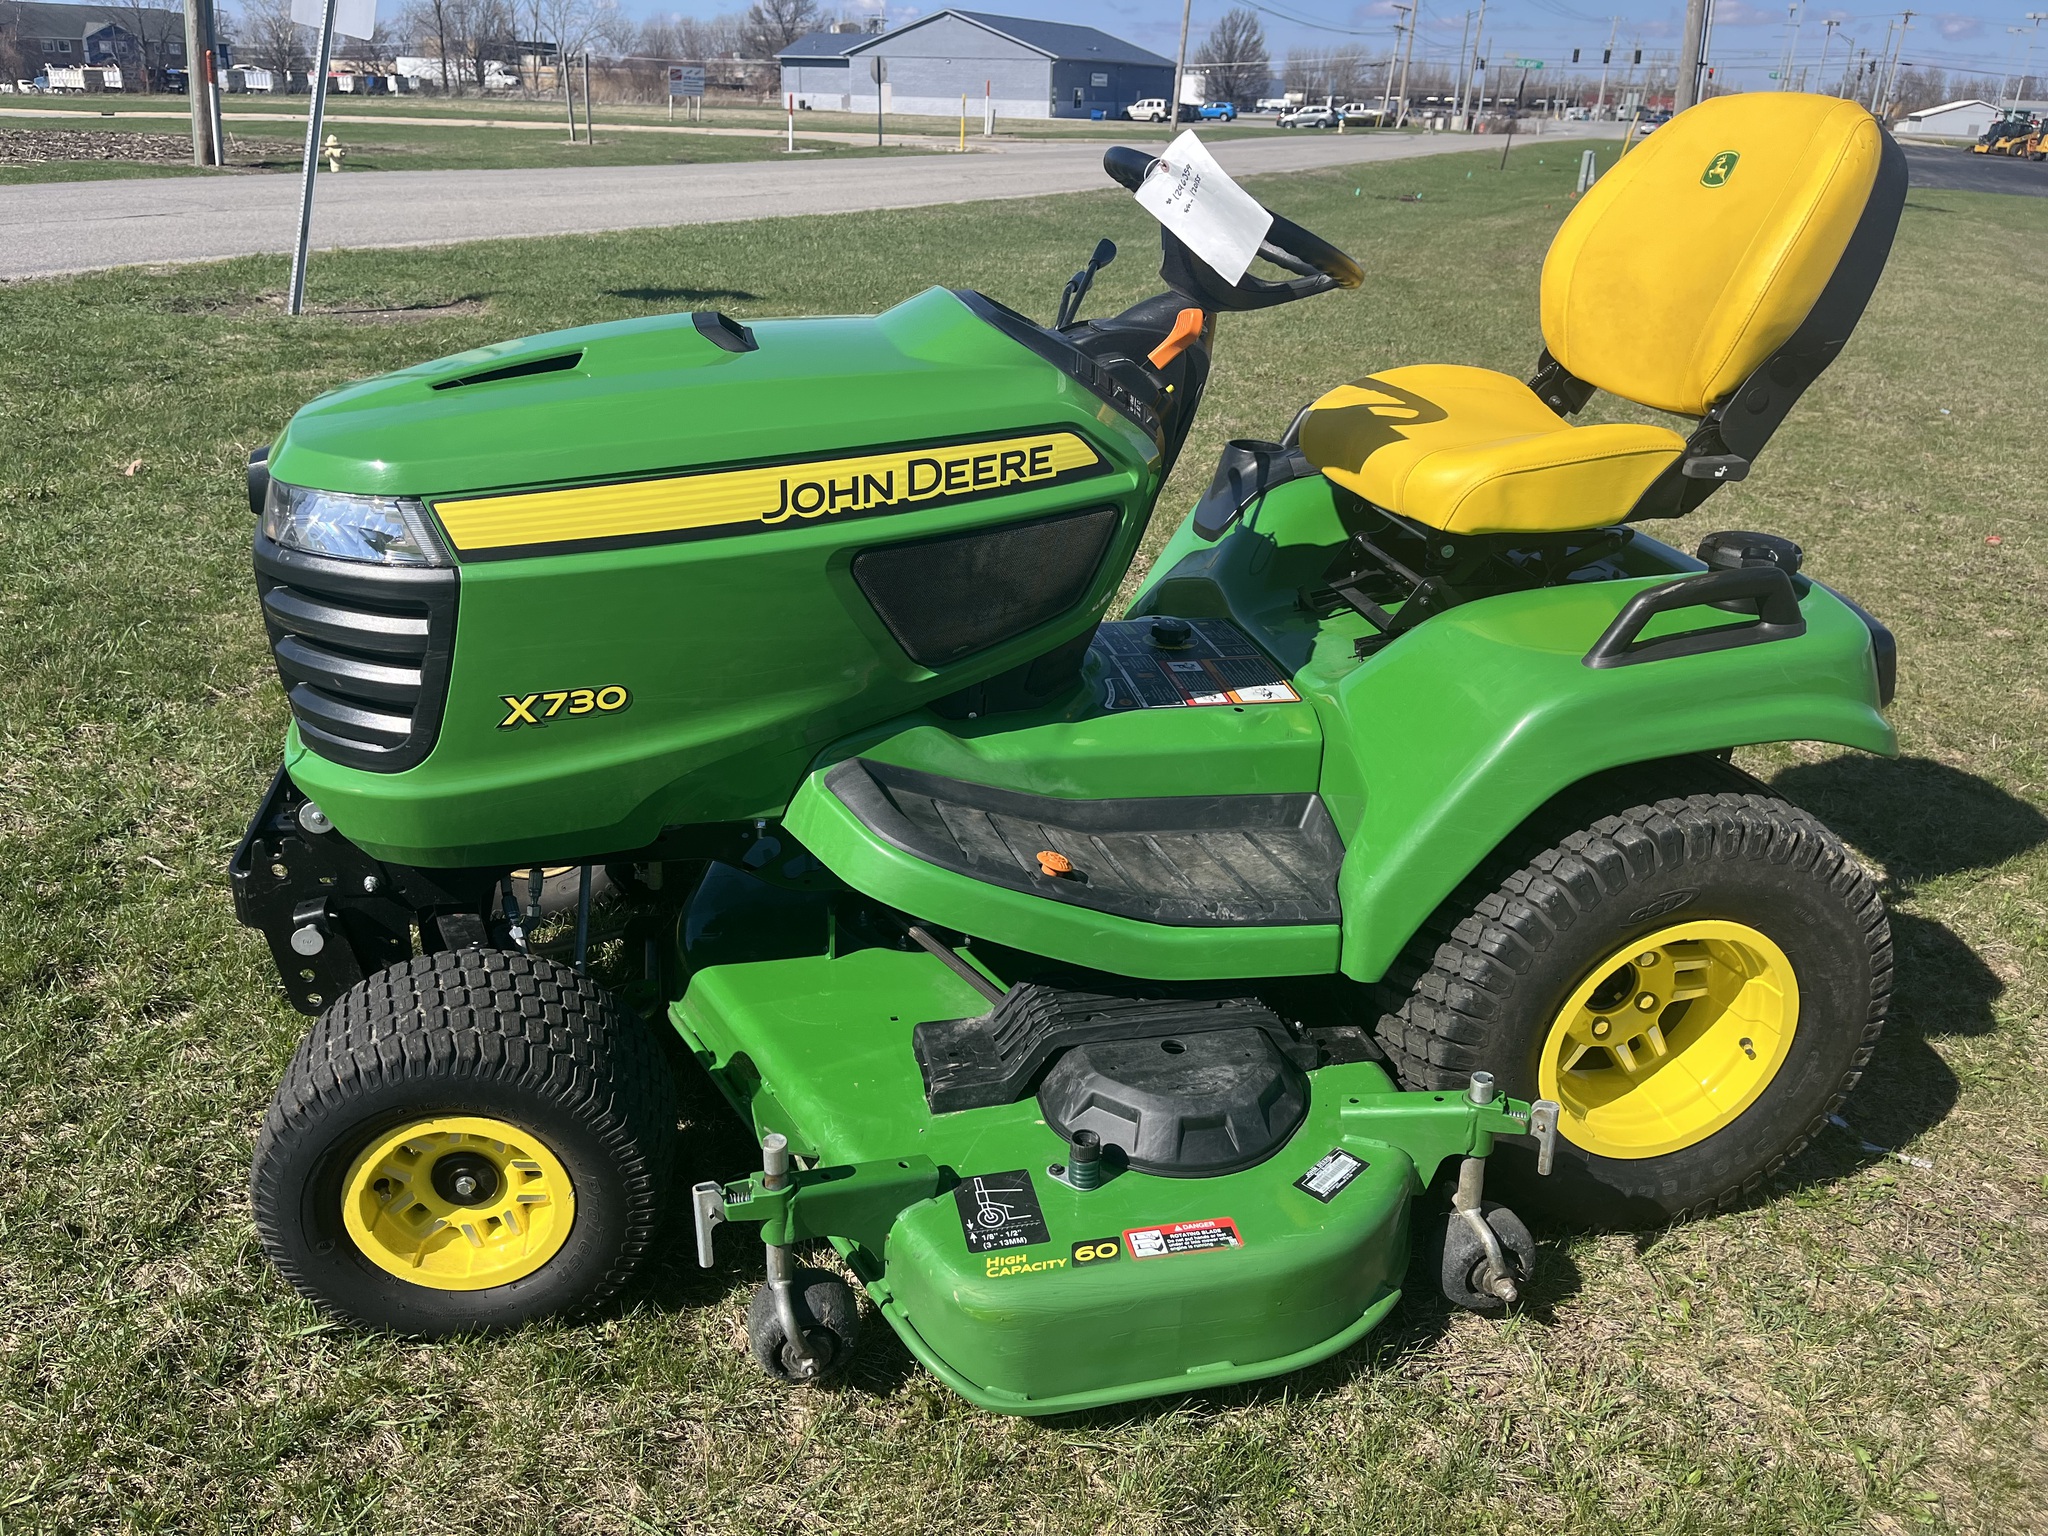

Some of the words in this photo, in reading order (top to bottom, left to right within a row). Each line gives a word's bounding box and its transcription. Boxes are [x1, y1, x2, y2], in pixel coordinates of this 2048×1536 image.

[761, 470, 895, 522] JOHN
[906, 444, 1055, 498] DEERE
[499, 684, 630, 729] X730
[1182, 1221, 1215, 1230] DANGER
[981, 1231, 998, 1241] 1/8"
[1005, 1229, 1022, 1238] 1/2"
[1169, 1230, 1201, 1239] ROTATING
[983, 1240, 992, 1250] (3
[999, 1237, 1028, 1246] 13MM)
[1074, 1242, 1119, 1262] 60
[985, 1257, 1068, 1279] CAPACITY
[986, 1253, 1027, 1269] HIGH
